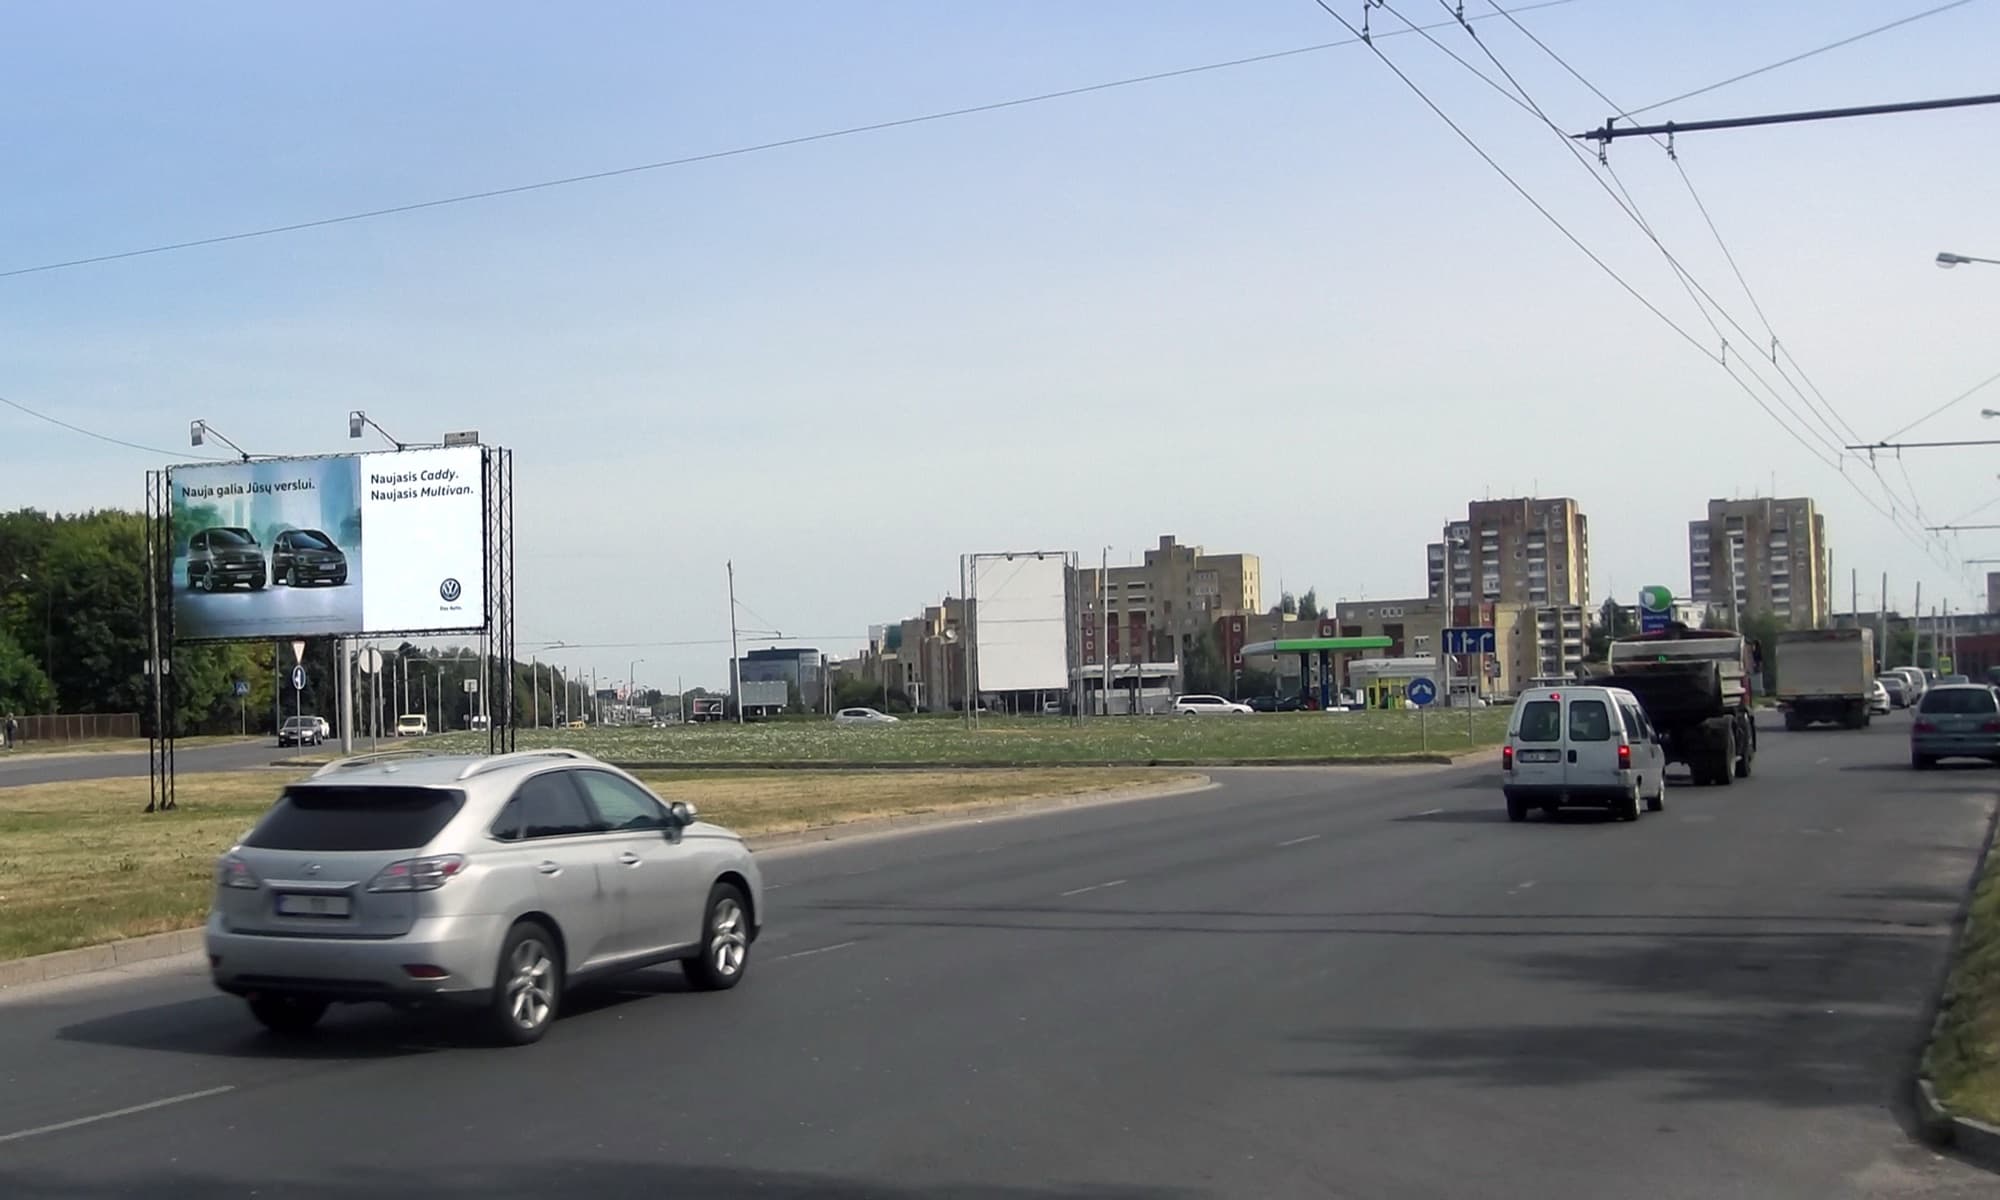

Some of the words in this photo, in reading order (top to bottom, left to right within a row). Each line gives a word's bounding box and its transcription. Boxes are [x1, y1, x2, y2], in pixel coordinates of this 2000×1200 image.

[371, 471, 417, 486] Naujasis
[420, 468, 459, 482] Caddy.
[182, 485, 214, 499] Nauja
[216, 483, 244, 498] galia
[246, 481, 272, 495] Jūsų
[274, 478, 316, 492] verslui.
[371, 487, 418, 502] Naujasis
[420, 485, 474, 497] Multivan.
